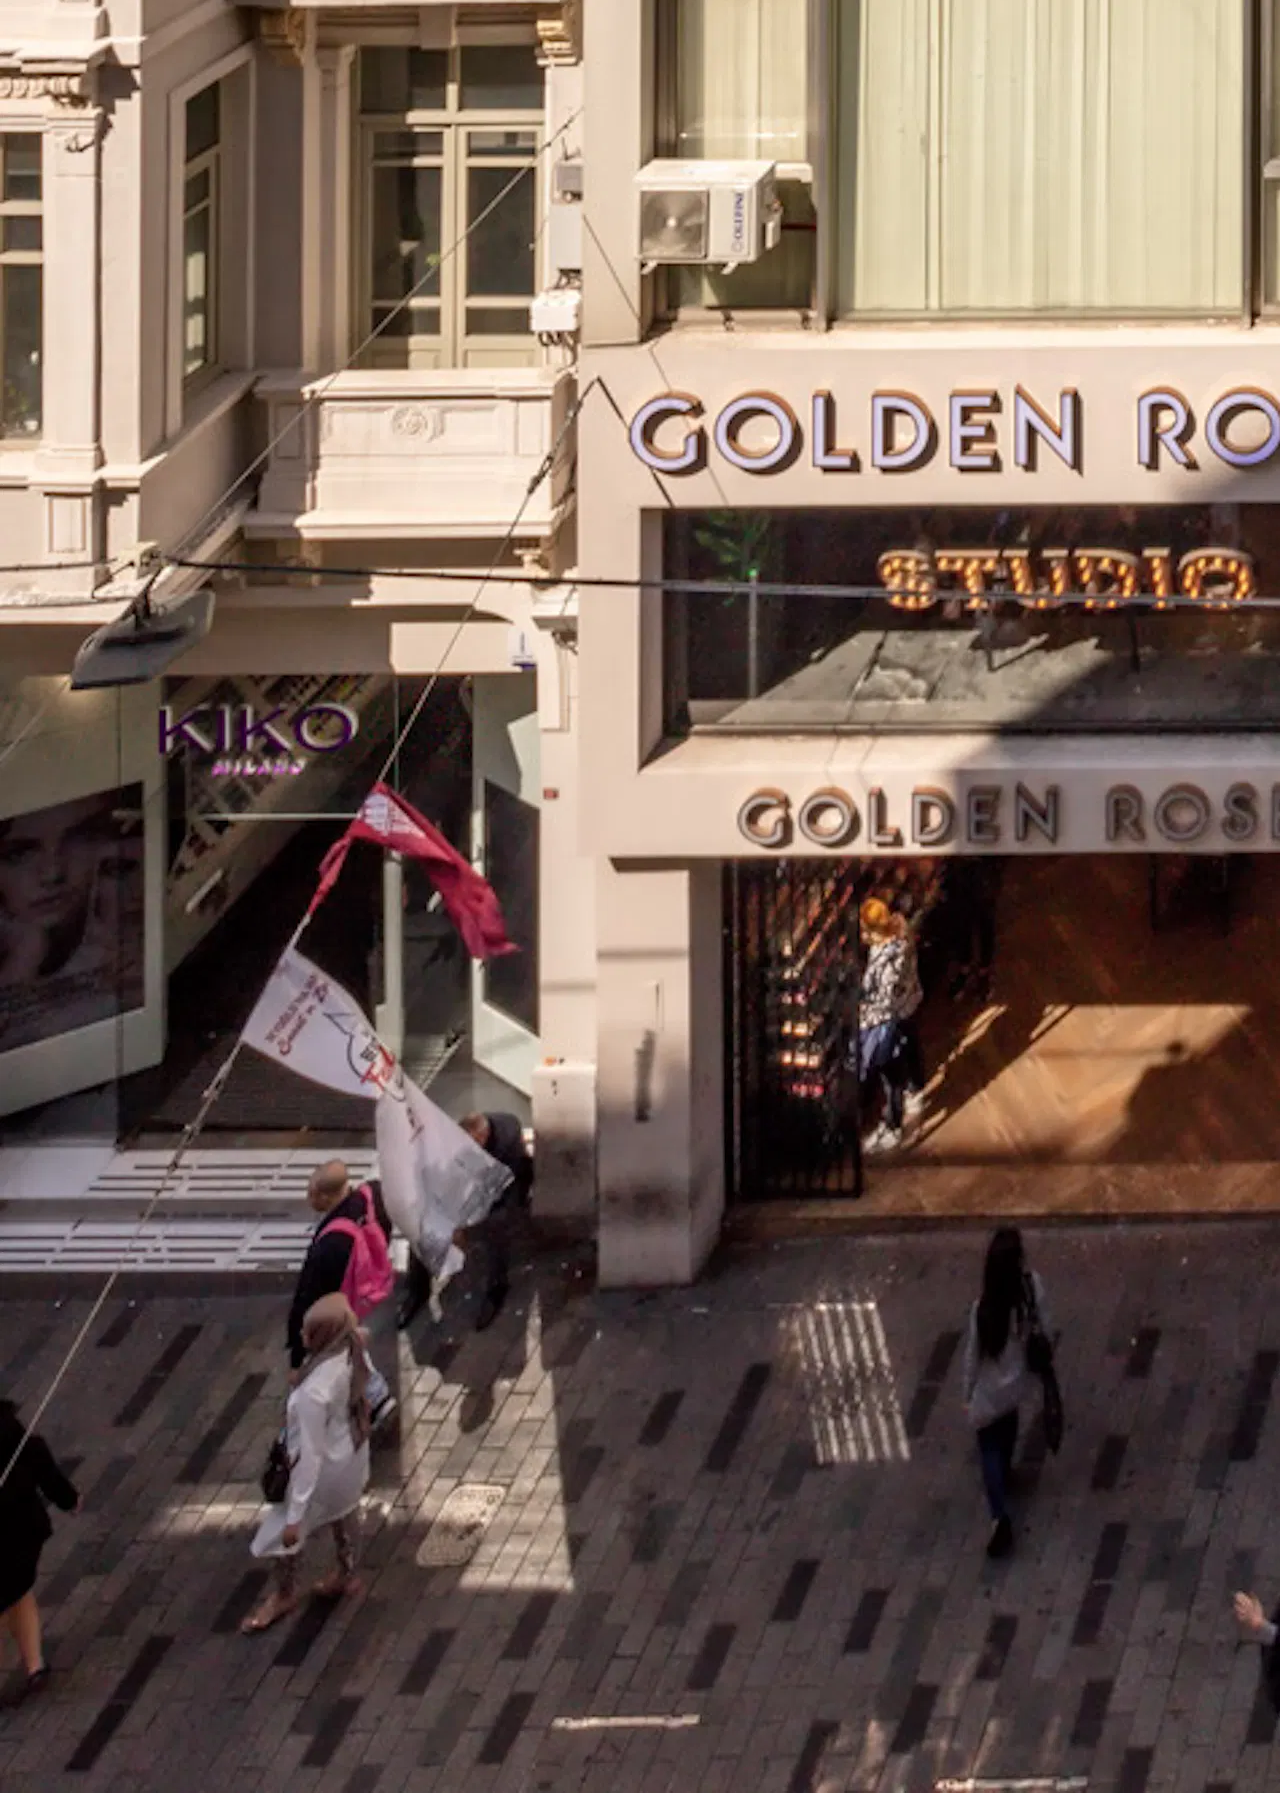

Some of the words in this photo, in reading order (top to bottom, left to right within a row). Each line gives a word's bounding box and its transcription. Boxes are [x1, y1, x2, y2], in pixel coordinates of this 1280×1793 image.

[630, 385, 1082, 475] GOLDEN
[877, 546, 1257, 612] STUDIO
[159, 702, 359, 754] KIKO
[212, 758, 307, 777] MILANO
[737, 782, 1061, 847] GOLDEN
